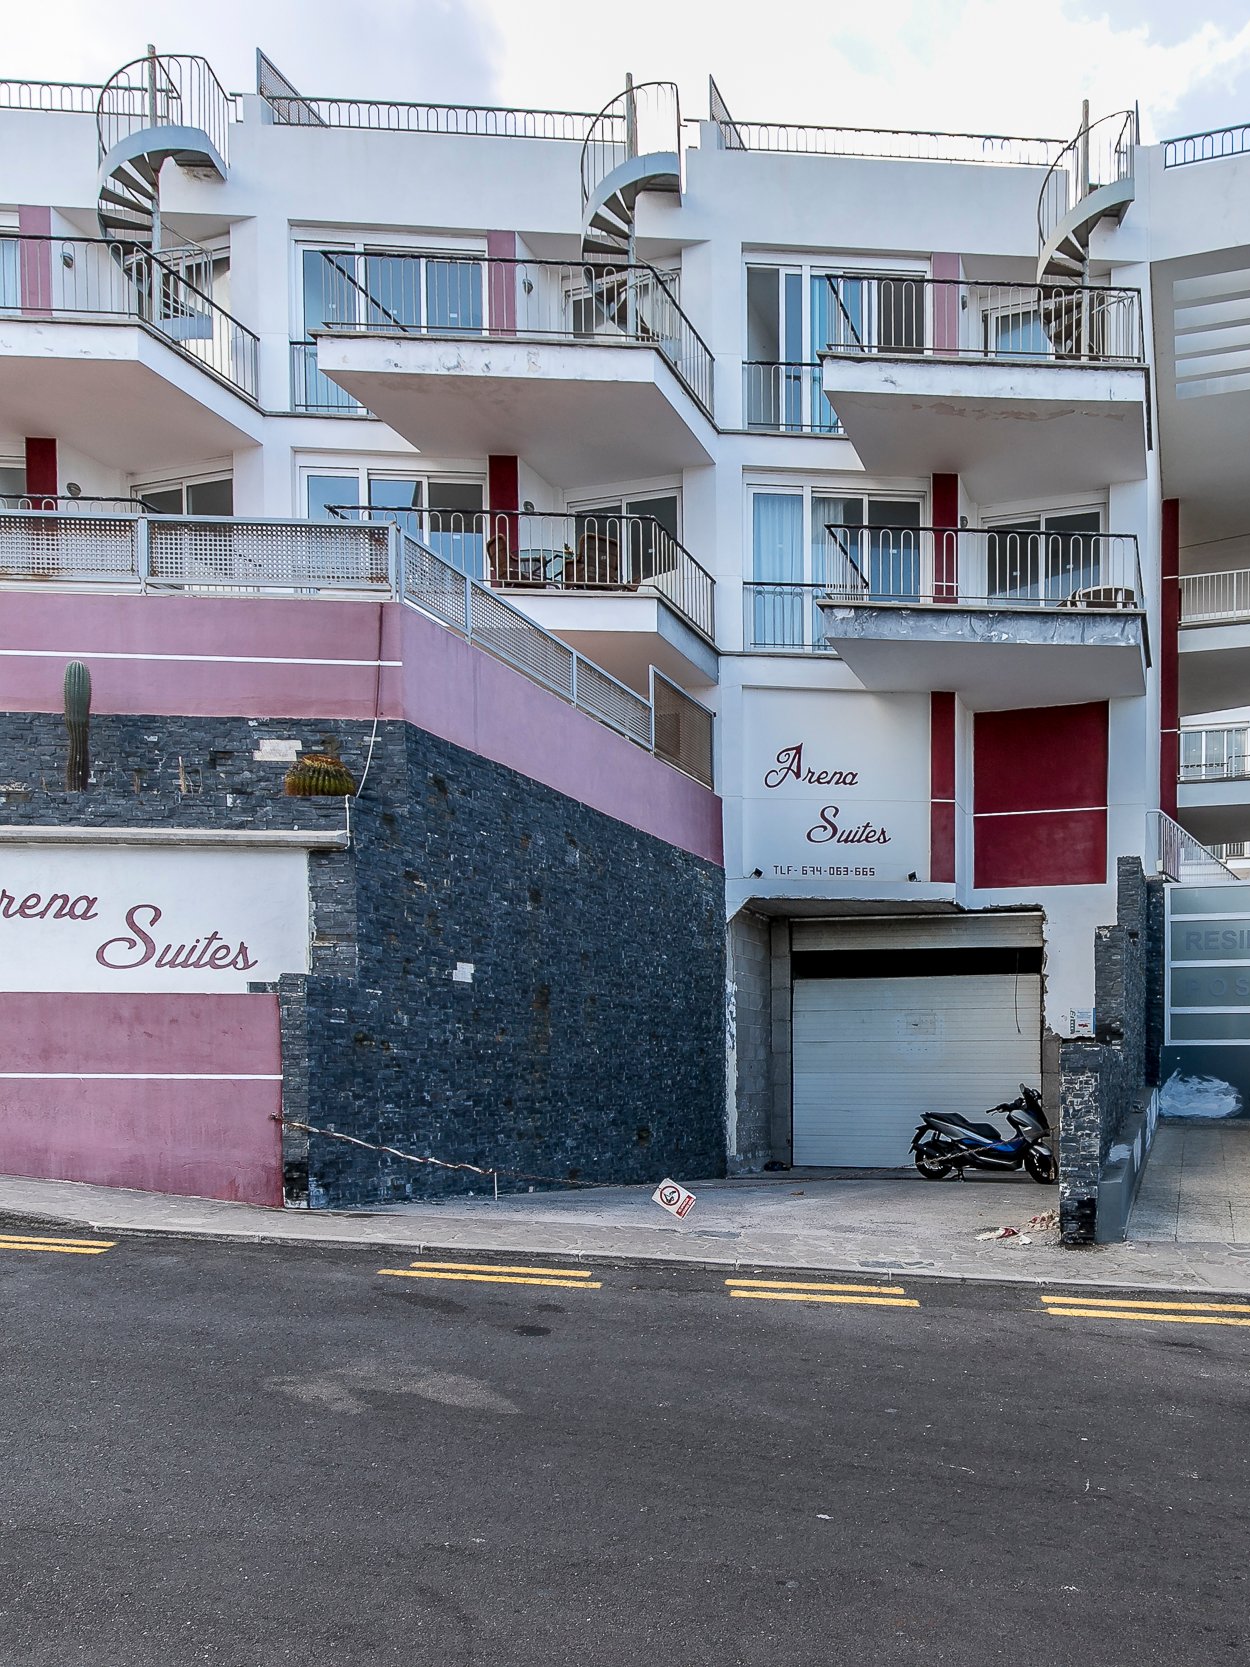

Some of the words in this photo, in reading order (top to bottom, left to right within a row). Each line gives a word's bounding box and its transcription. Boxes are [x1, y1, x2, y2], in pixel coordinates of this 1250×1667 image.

[764, 742, 859, 788] Arena
[806, 805, 892, 845] Suites
[0, 888, 99, 920] rena
[95, 903, 259, 970] Suites
